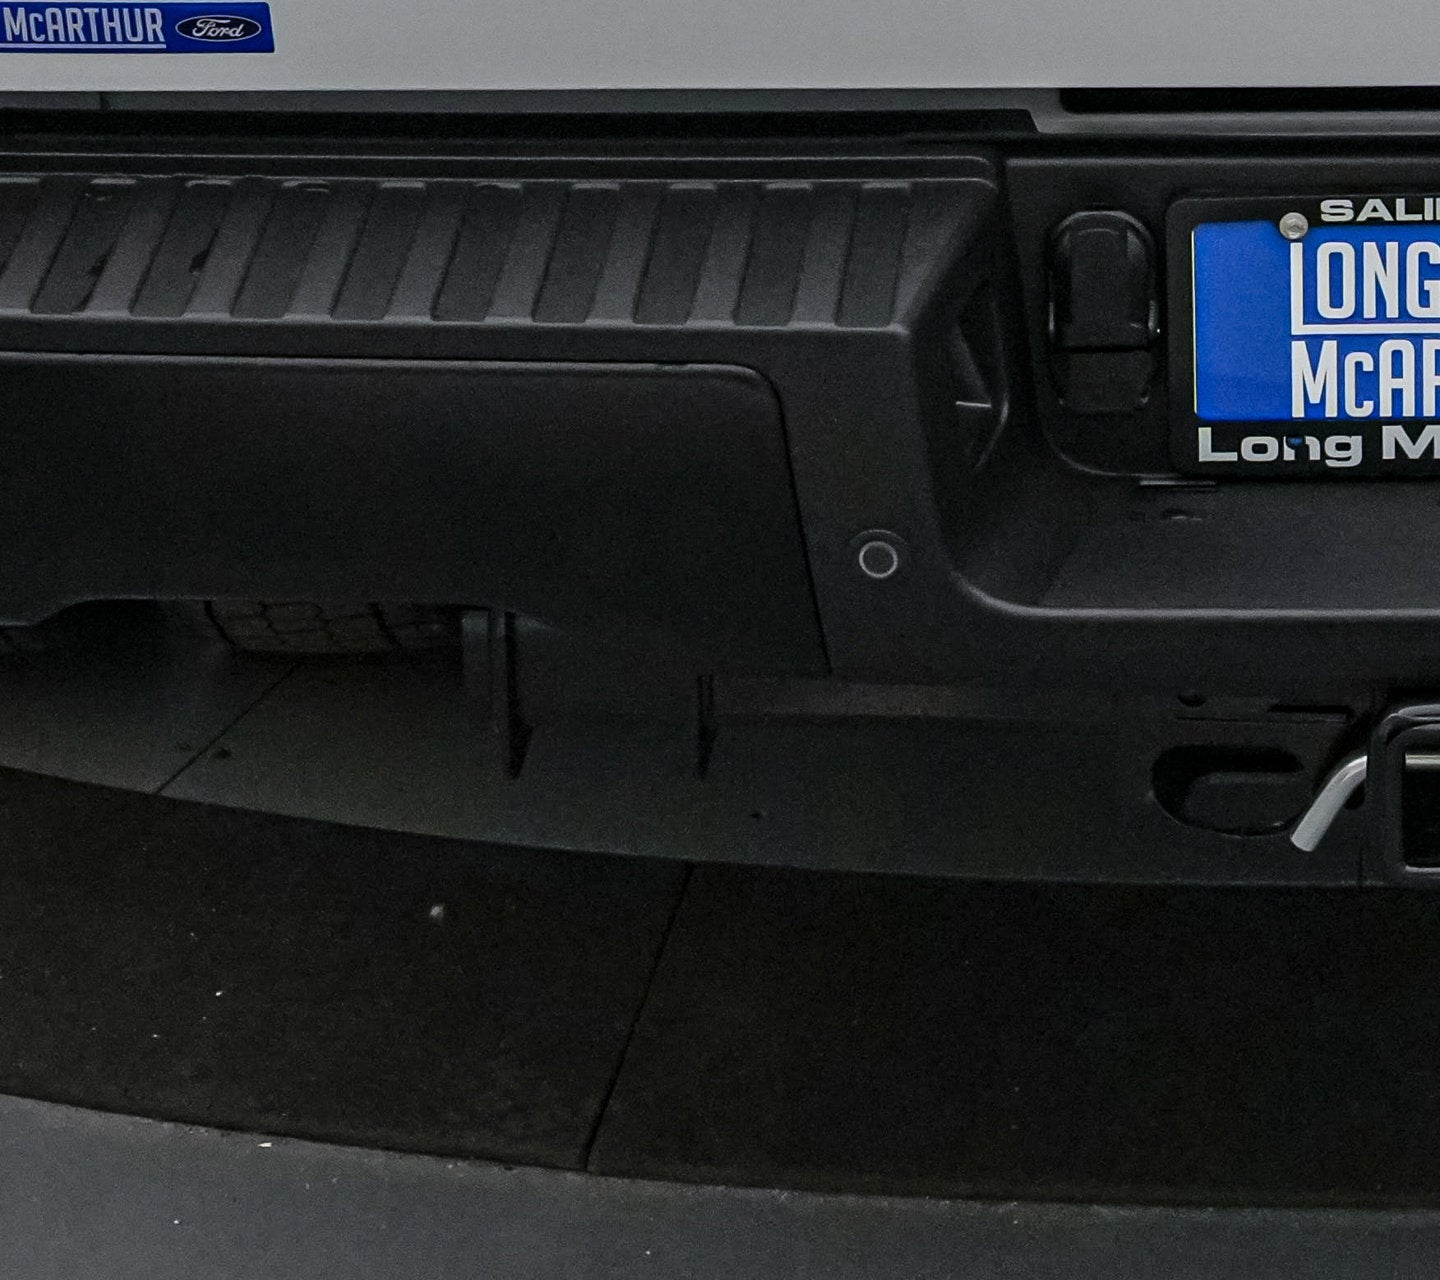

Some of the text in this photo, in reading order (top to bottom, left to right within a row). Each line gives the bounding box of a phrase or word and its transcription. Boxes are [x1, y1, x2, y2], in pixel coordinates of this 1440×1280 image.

[4, 7, 167, 43] McARTHUR
[190, 18, 245, 39] Ford
[1197, 426, 1364, 468] Long
